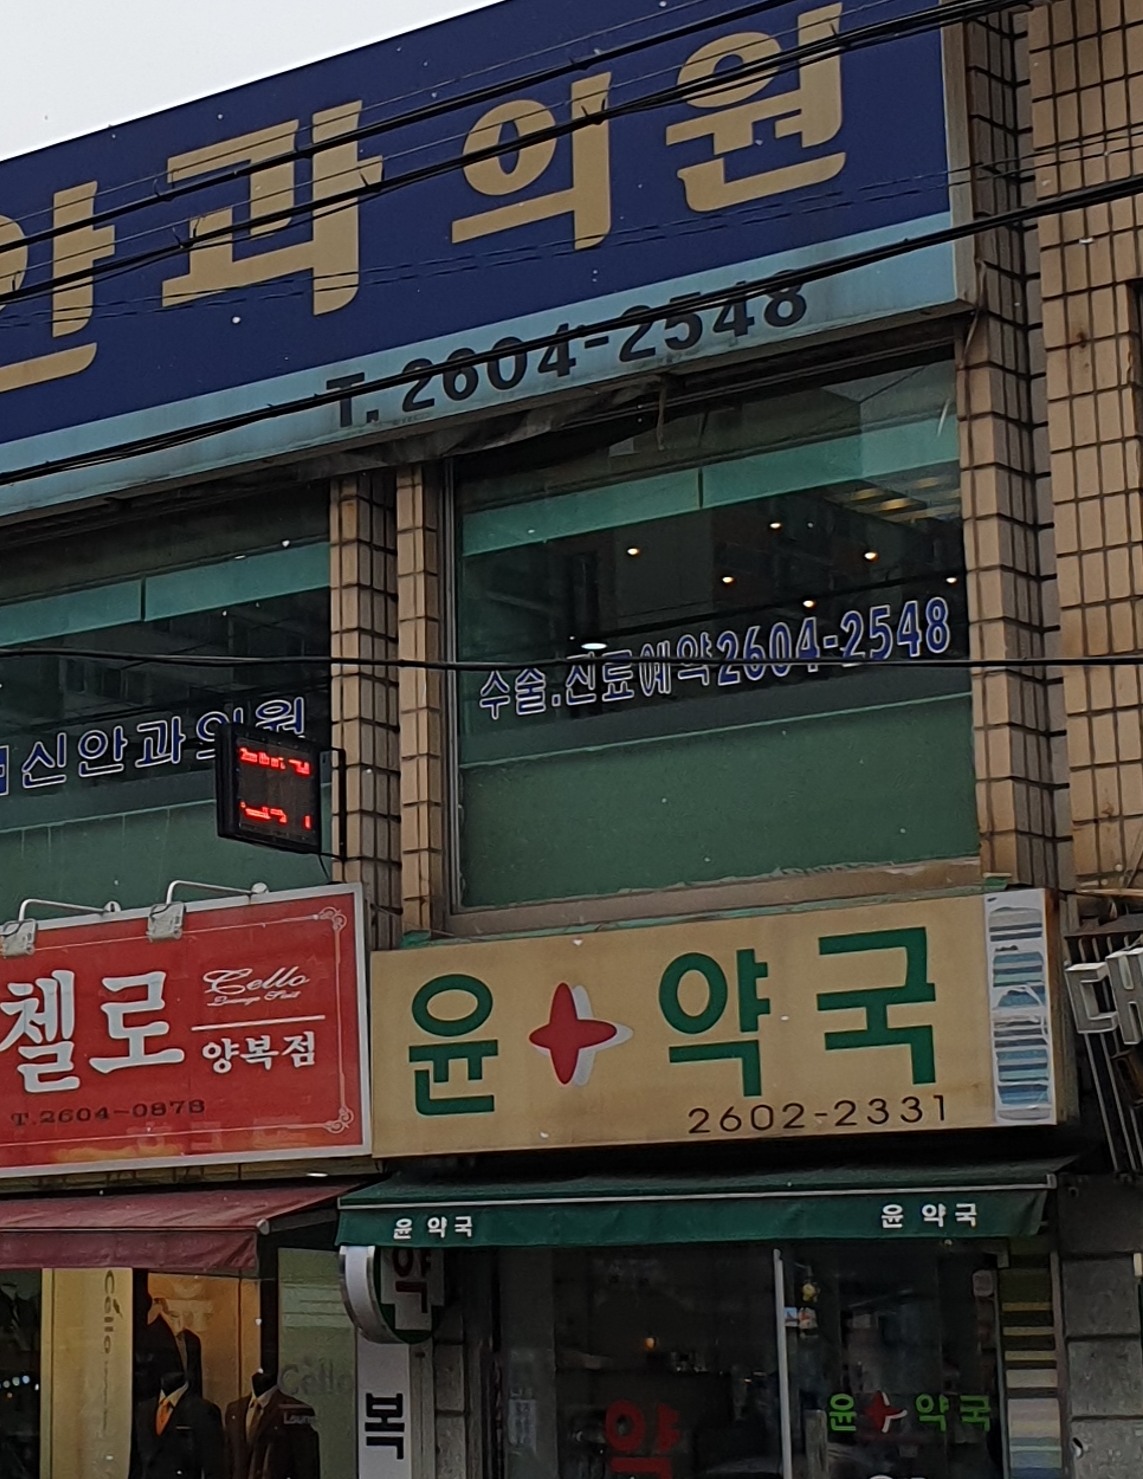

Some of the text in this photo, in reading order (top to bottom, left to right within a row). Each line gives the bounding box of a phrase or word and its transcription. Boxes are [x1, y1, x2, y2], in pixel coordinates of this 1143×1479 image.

[203, 965, 310, 995] Cello
[409, 926, 936, 1117] 윤 약국
[201, 1031, 316, 1074] 양복점
[687, 1094, 949, 1134] 2602-2331
[393, 1215, 473, 1240] 윤 약국
[880, 1202, 978, 1229] 윤 약국
[365, 1393, 405, 1460] 복
